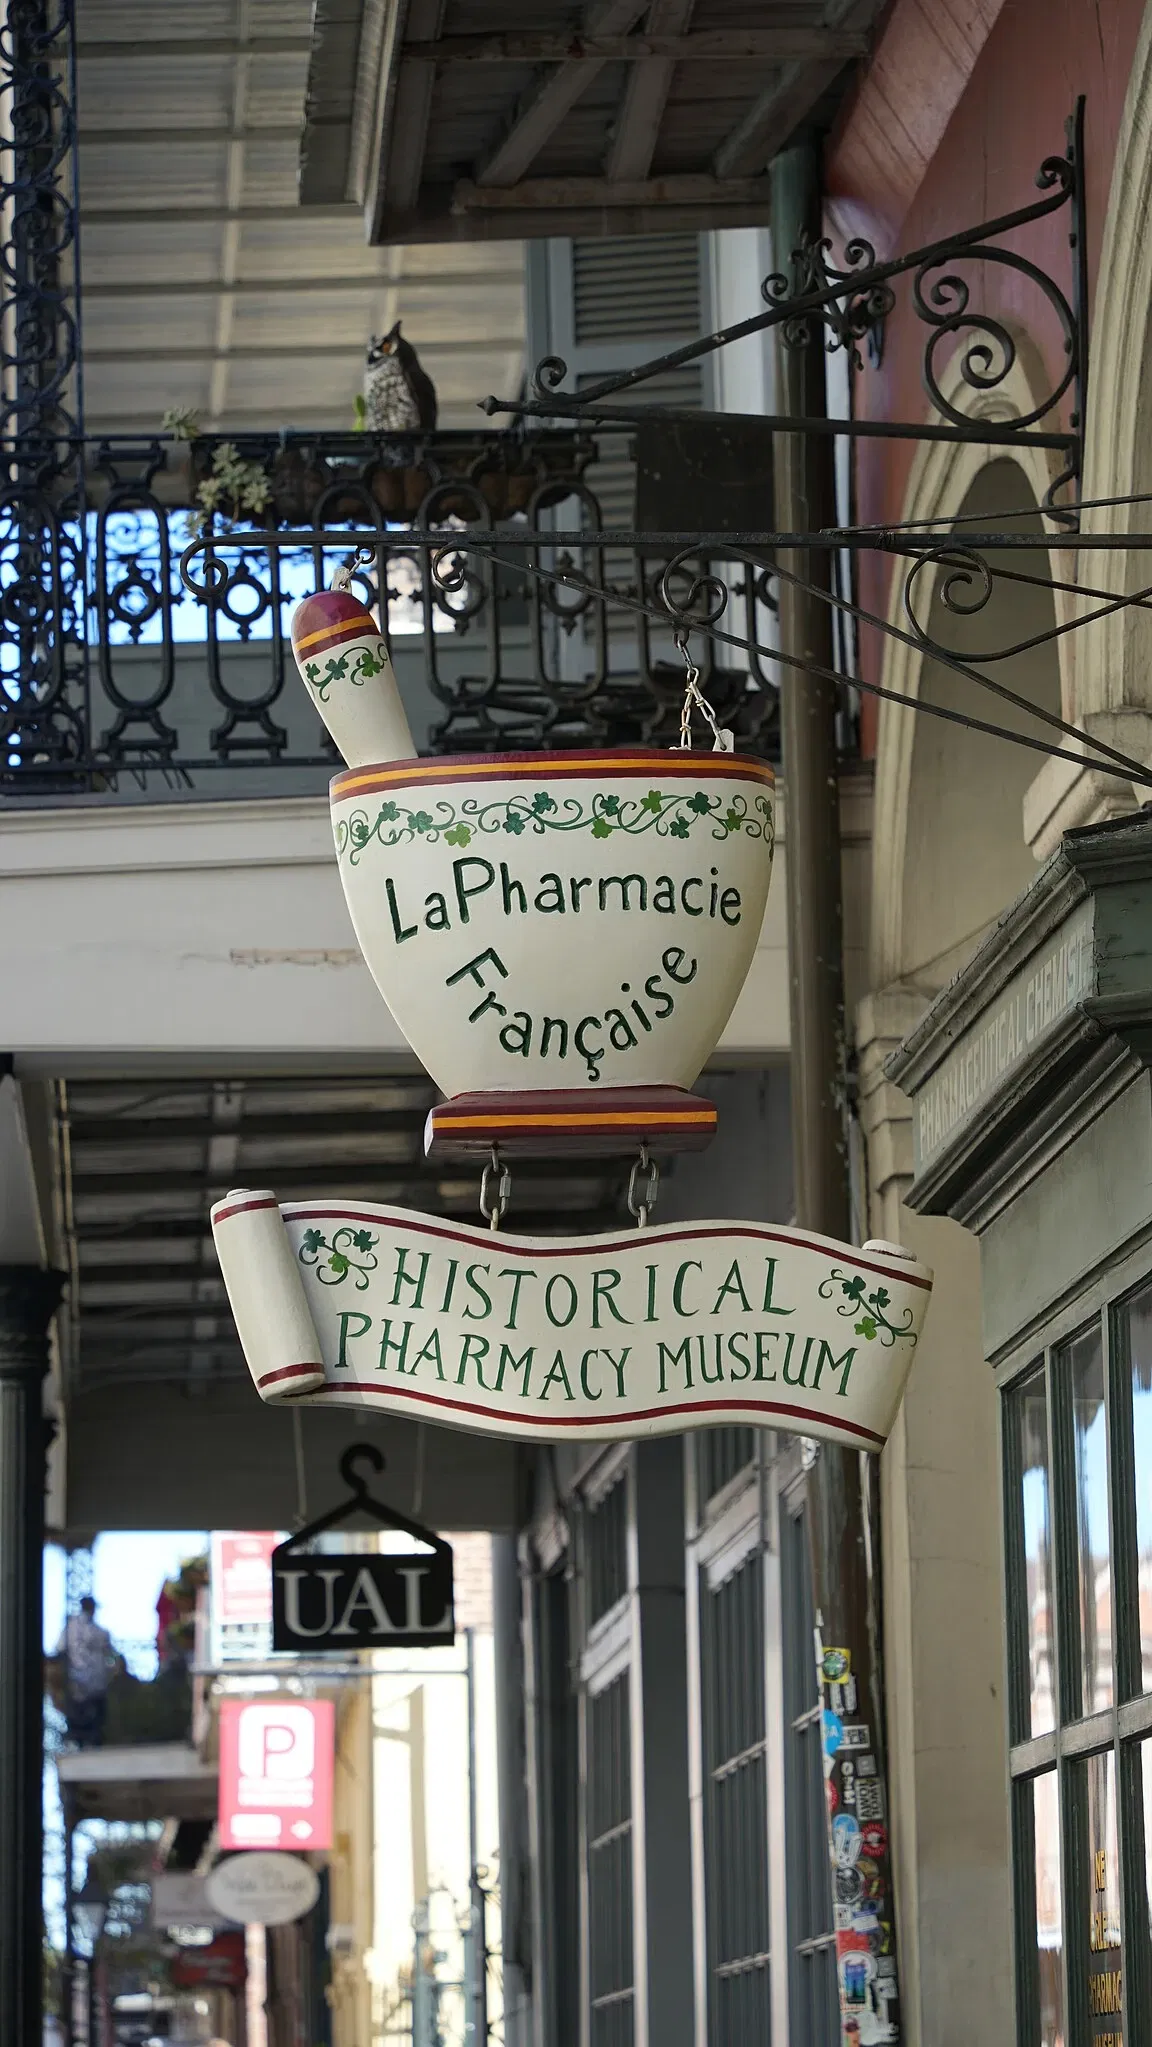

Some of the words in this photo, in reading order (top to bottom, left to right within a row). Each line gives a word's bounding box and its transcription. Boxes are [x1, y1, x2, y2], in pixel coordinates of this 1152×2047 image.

[445, 947, 698, 1082] Française
[918, 994, 1023, 1162] PHARMACEUTICAL
[386, 1246, 797, 1330] HISTORICAL
[334, 1311, 634, 1402] PHARMACY
[656, 1331, 858, 1398] MUSEUM
[276, 1567, 453, 1638] UAL
[262, 1725, 296, 1777] P
